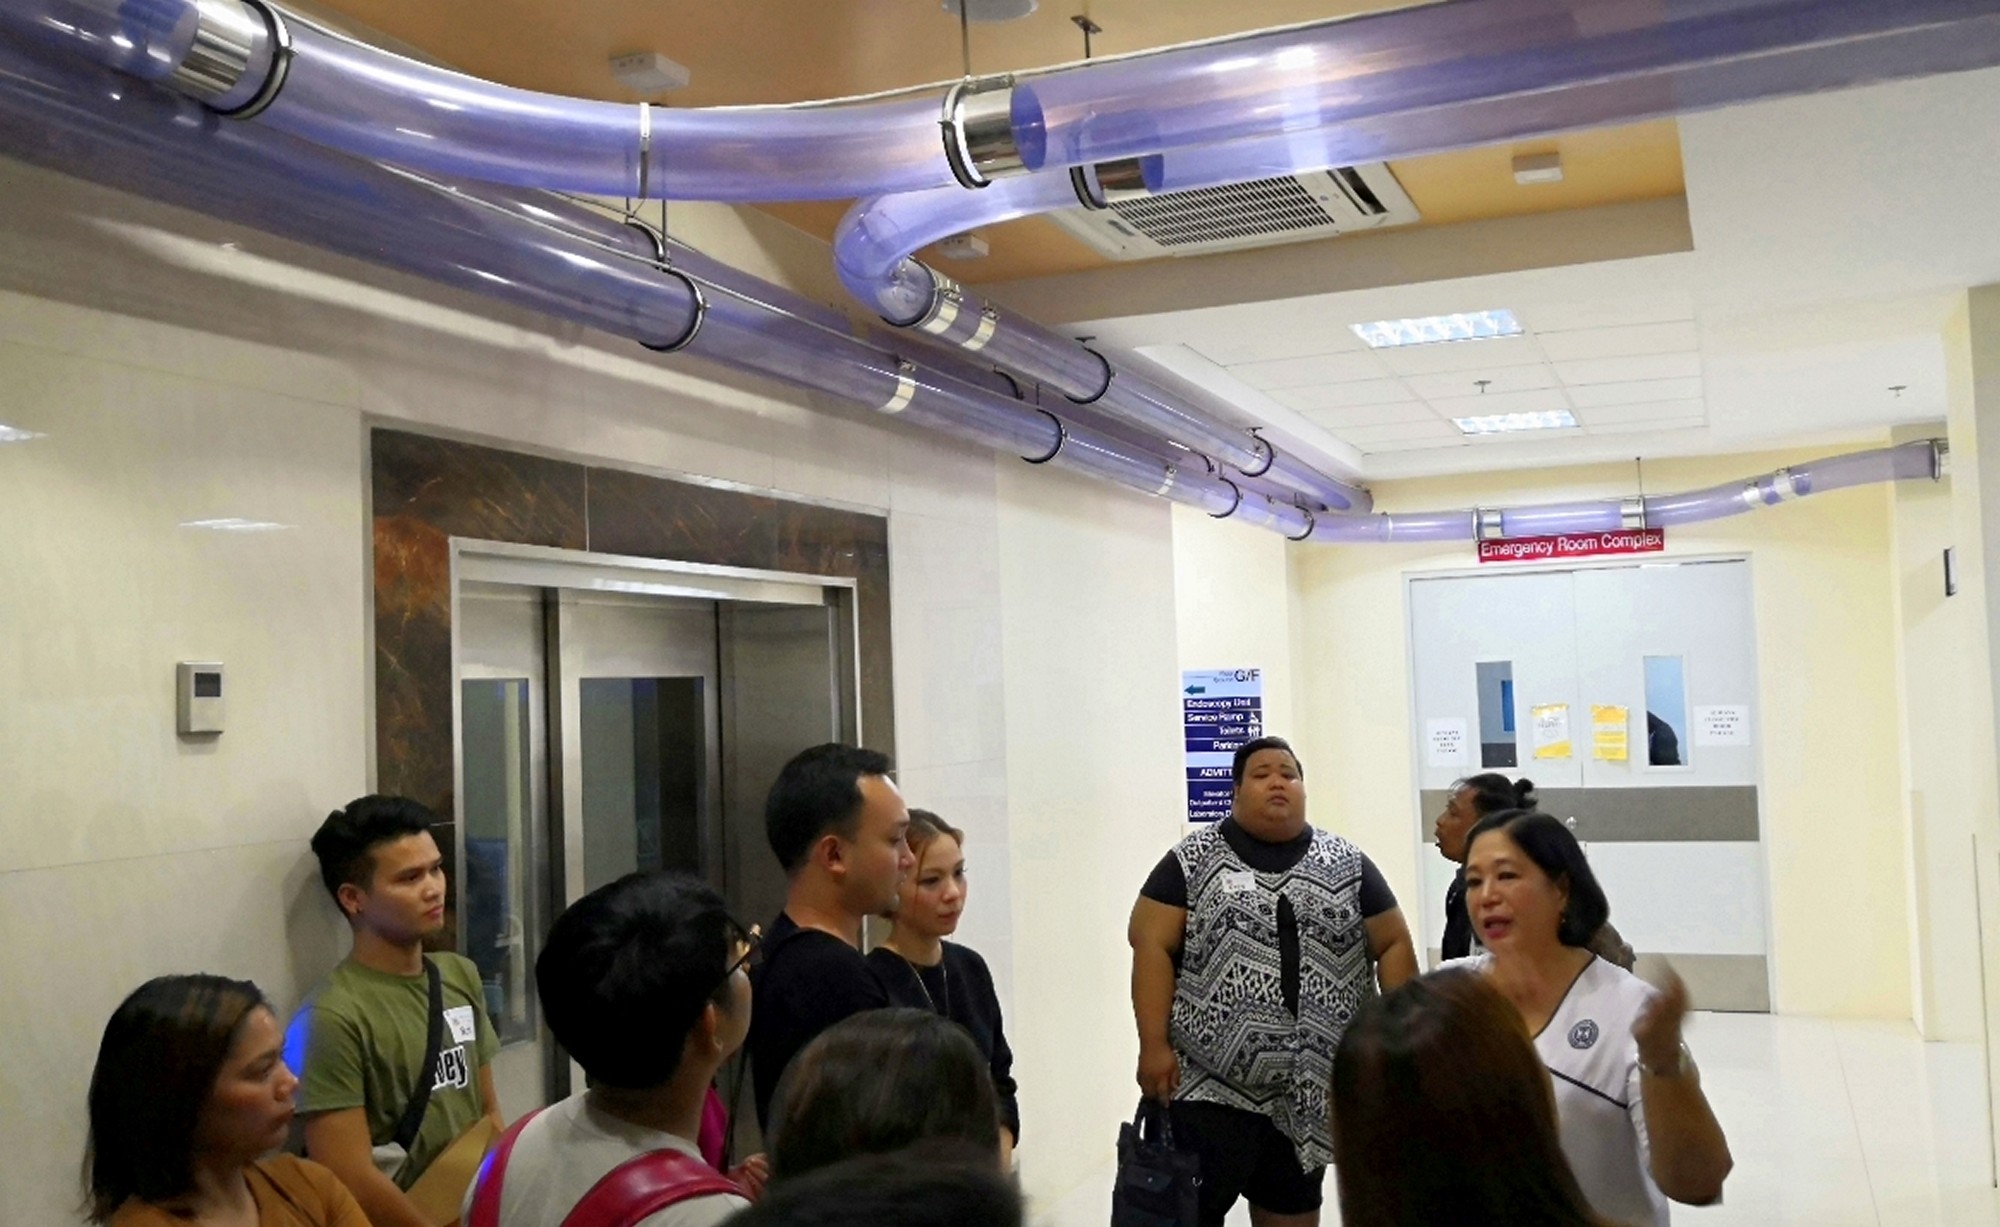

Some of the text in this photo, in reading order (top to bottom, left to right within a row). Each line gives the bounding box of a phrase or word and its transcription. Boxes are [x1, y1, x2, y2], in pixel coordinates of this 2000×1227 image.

[1481, 533, 1662, 558] Emergency Room Complex
[1233, 668, 1261, 682] G/F
[1200, 768, 1233, 777] ADMITT
